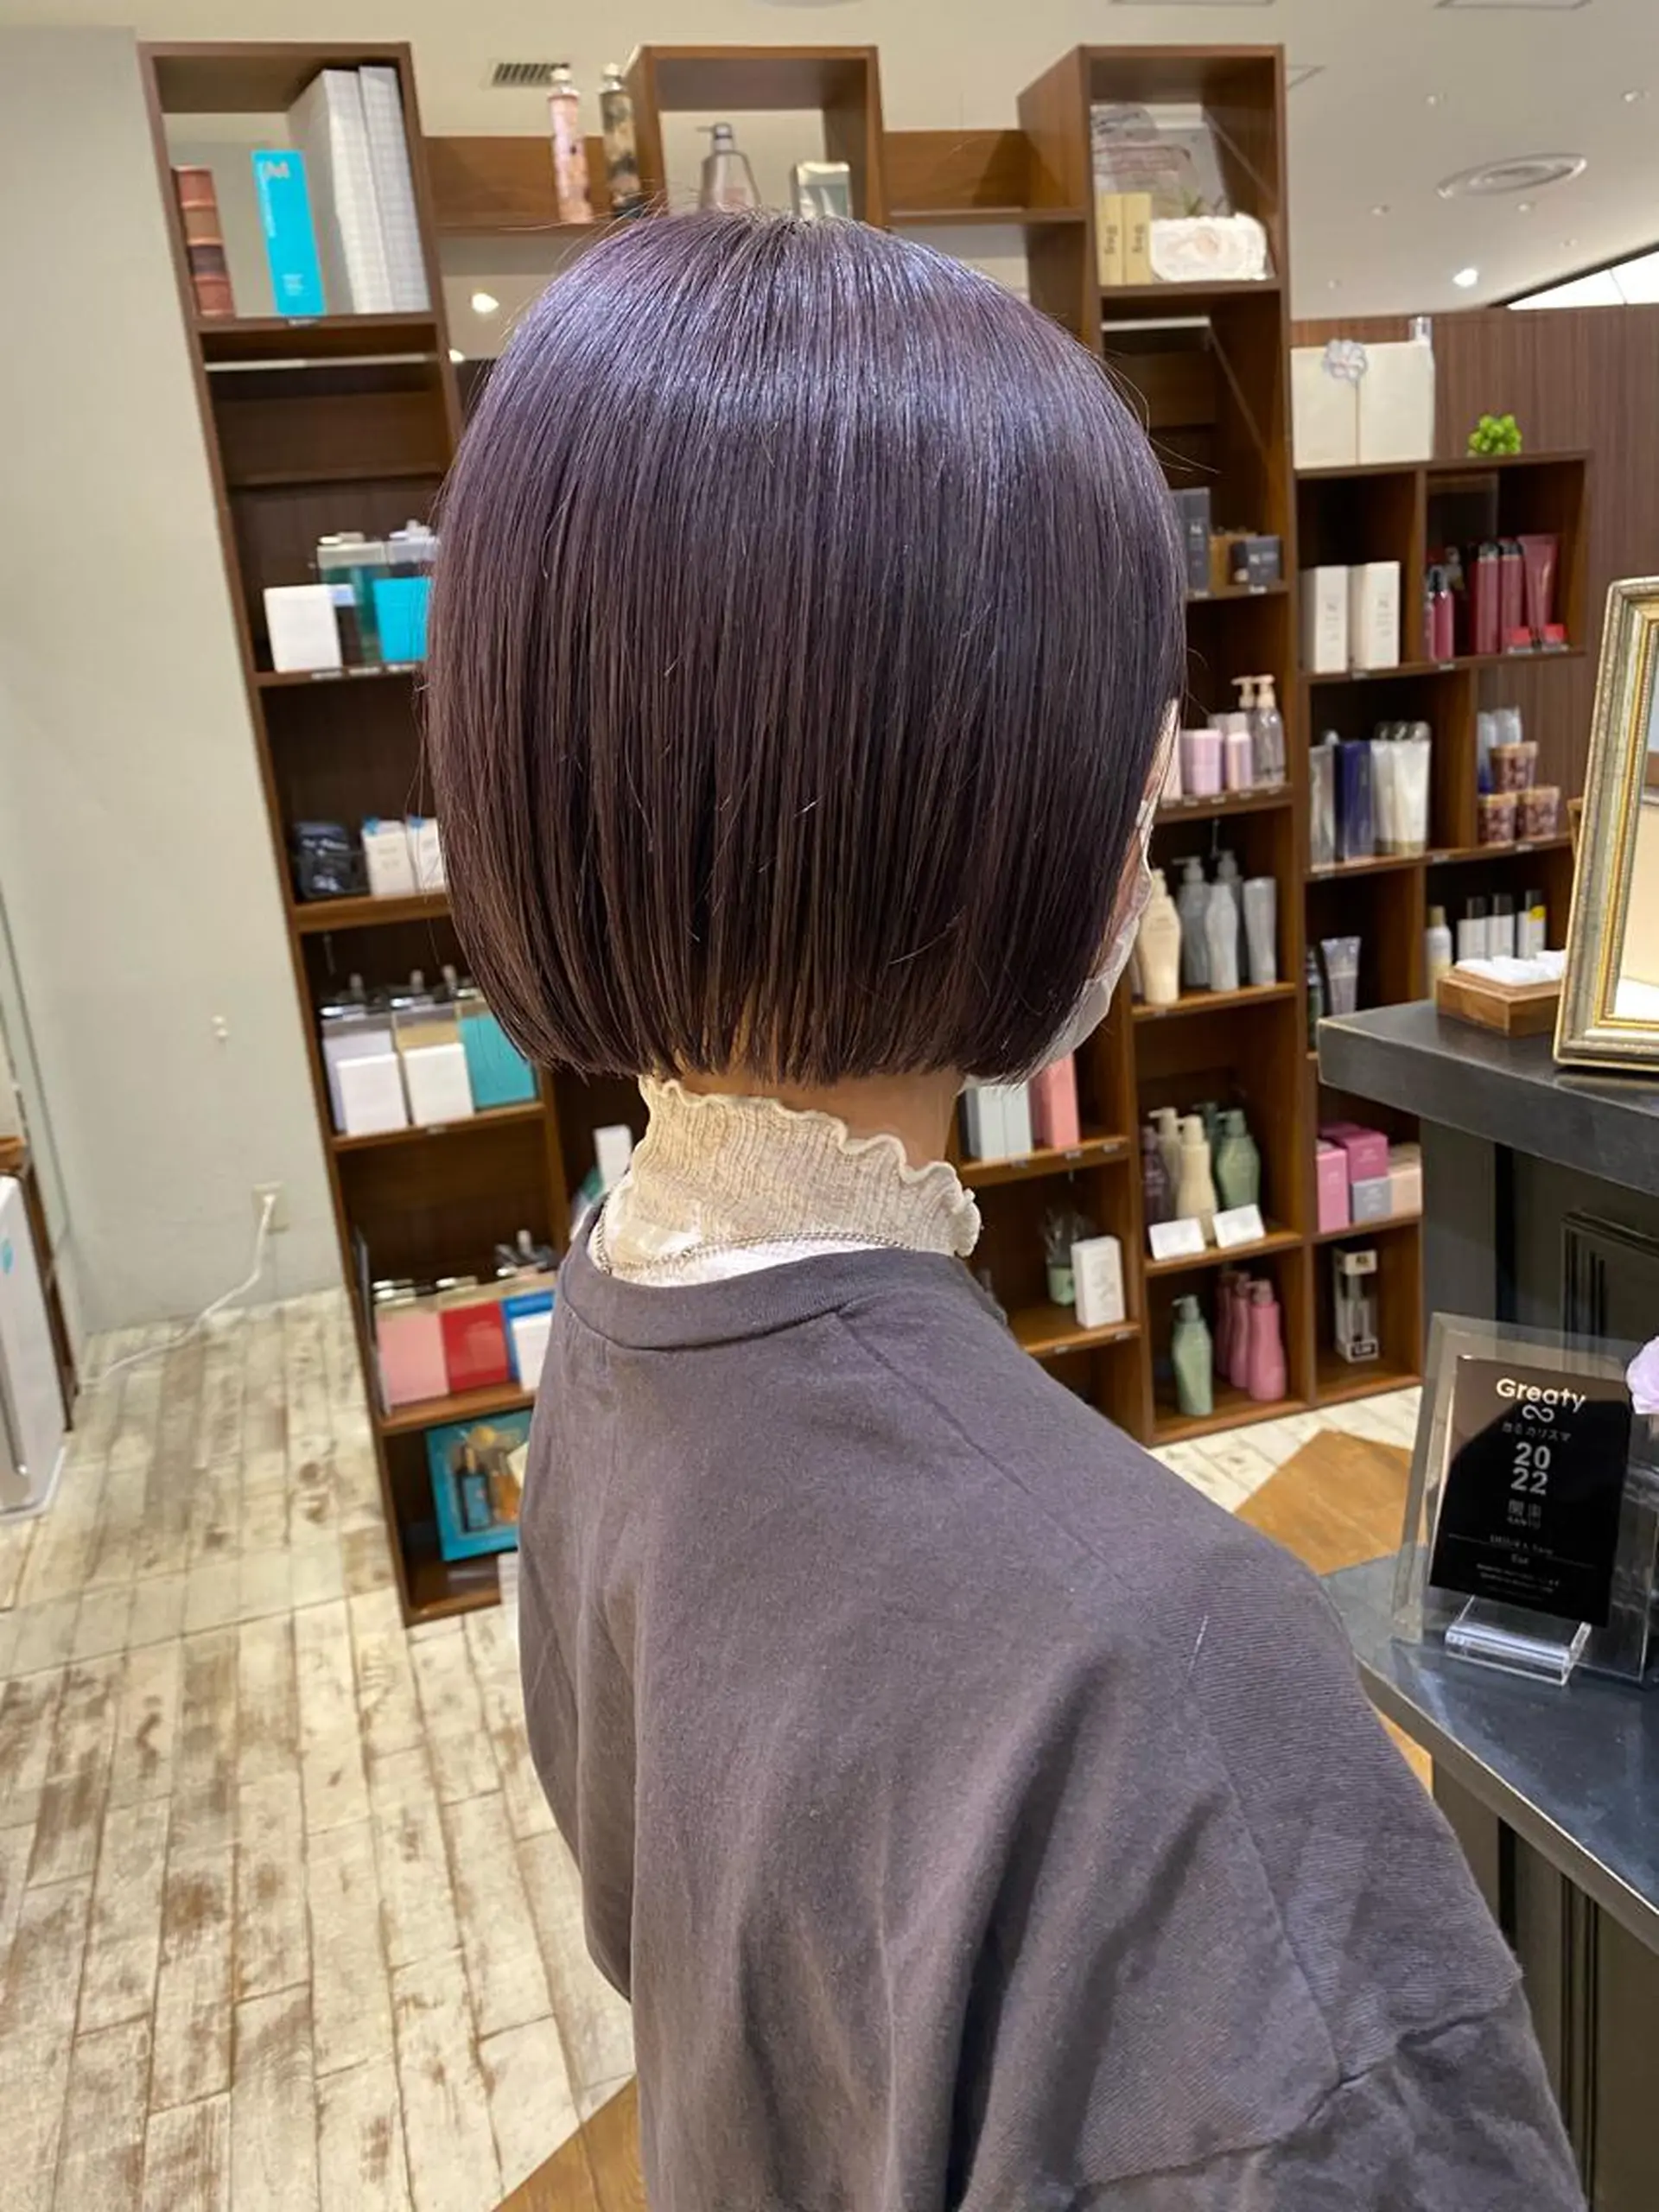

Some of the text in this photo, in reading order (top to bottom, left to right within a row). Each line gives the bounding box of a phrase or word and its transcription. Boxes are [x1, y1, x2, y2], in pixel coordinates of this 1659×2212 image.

[1496, 1377, 1586, 1413] Greaty
[1514, 1441, 1552, 1470] 20
[1510, 1467, 1548, 1496] 22
